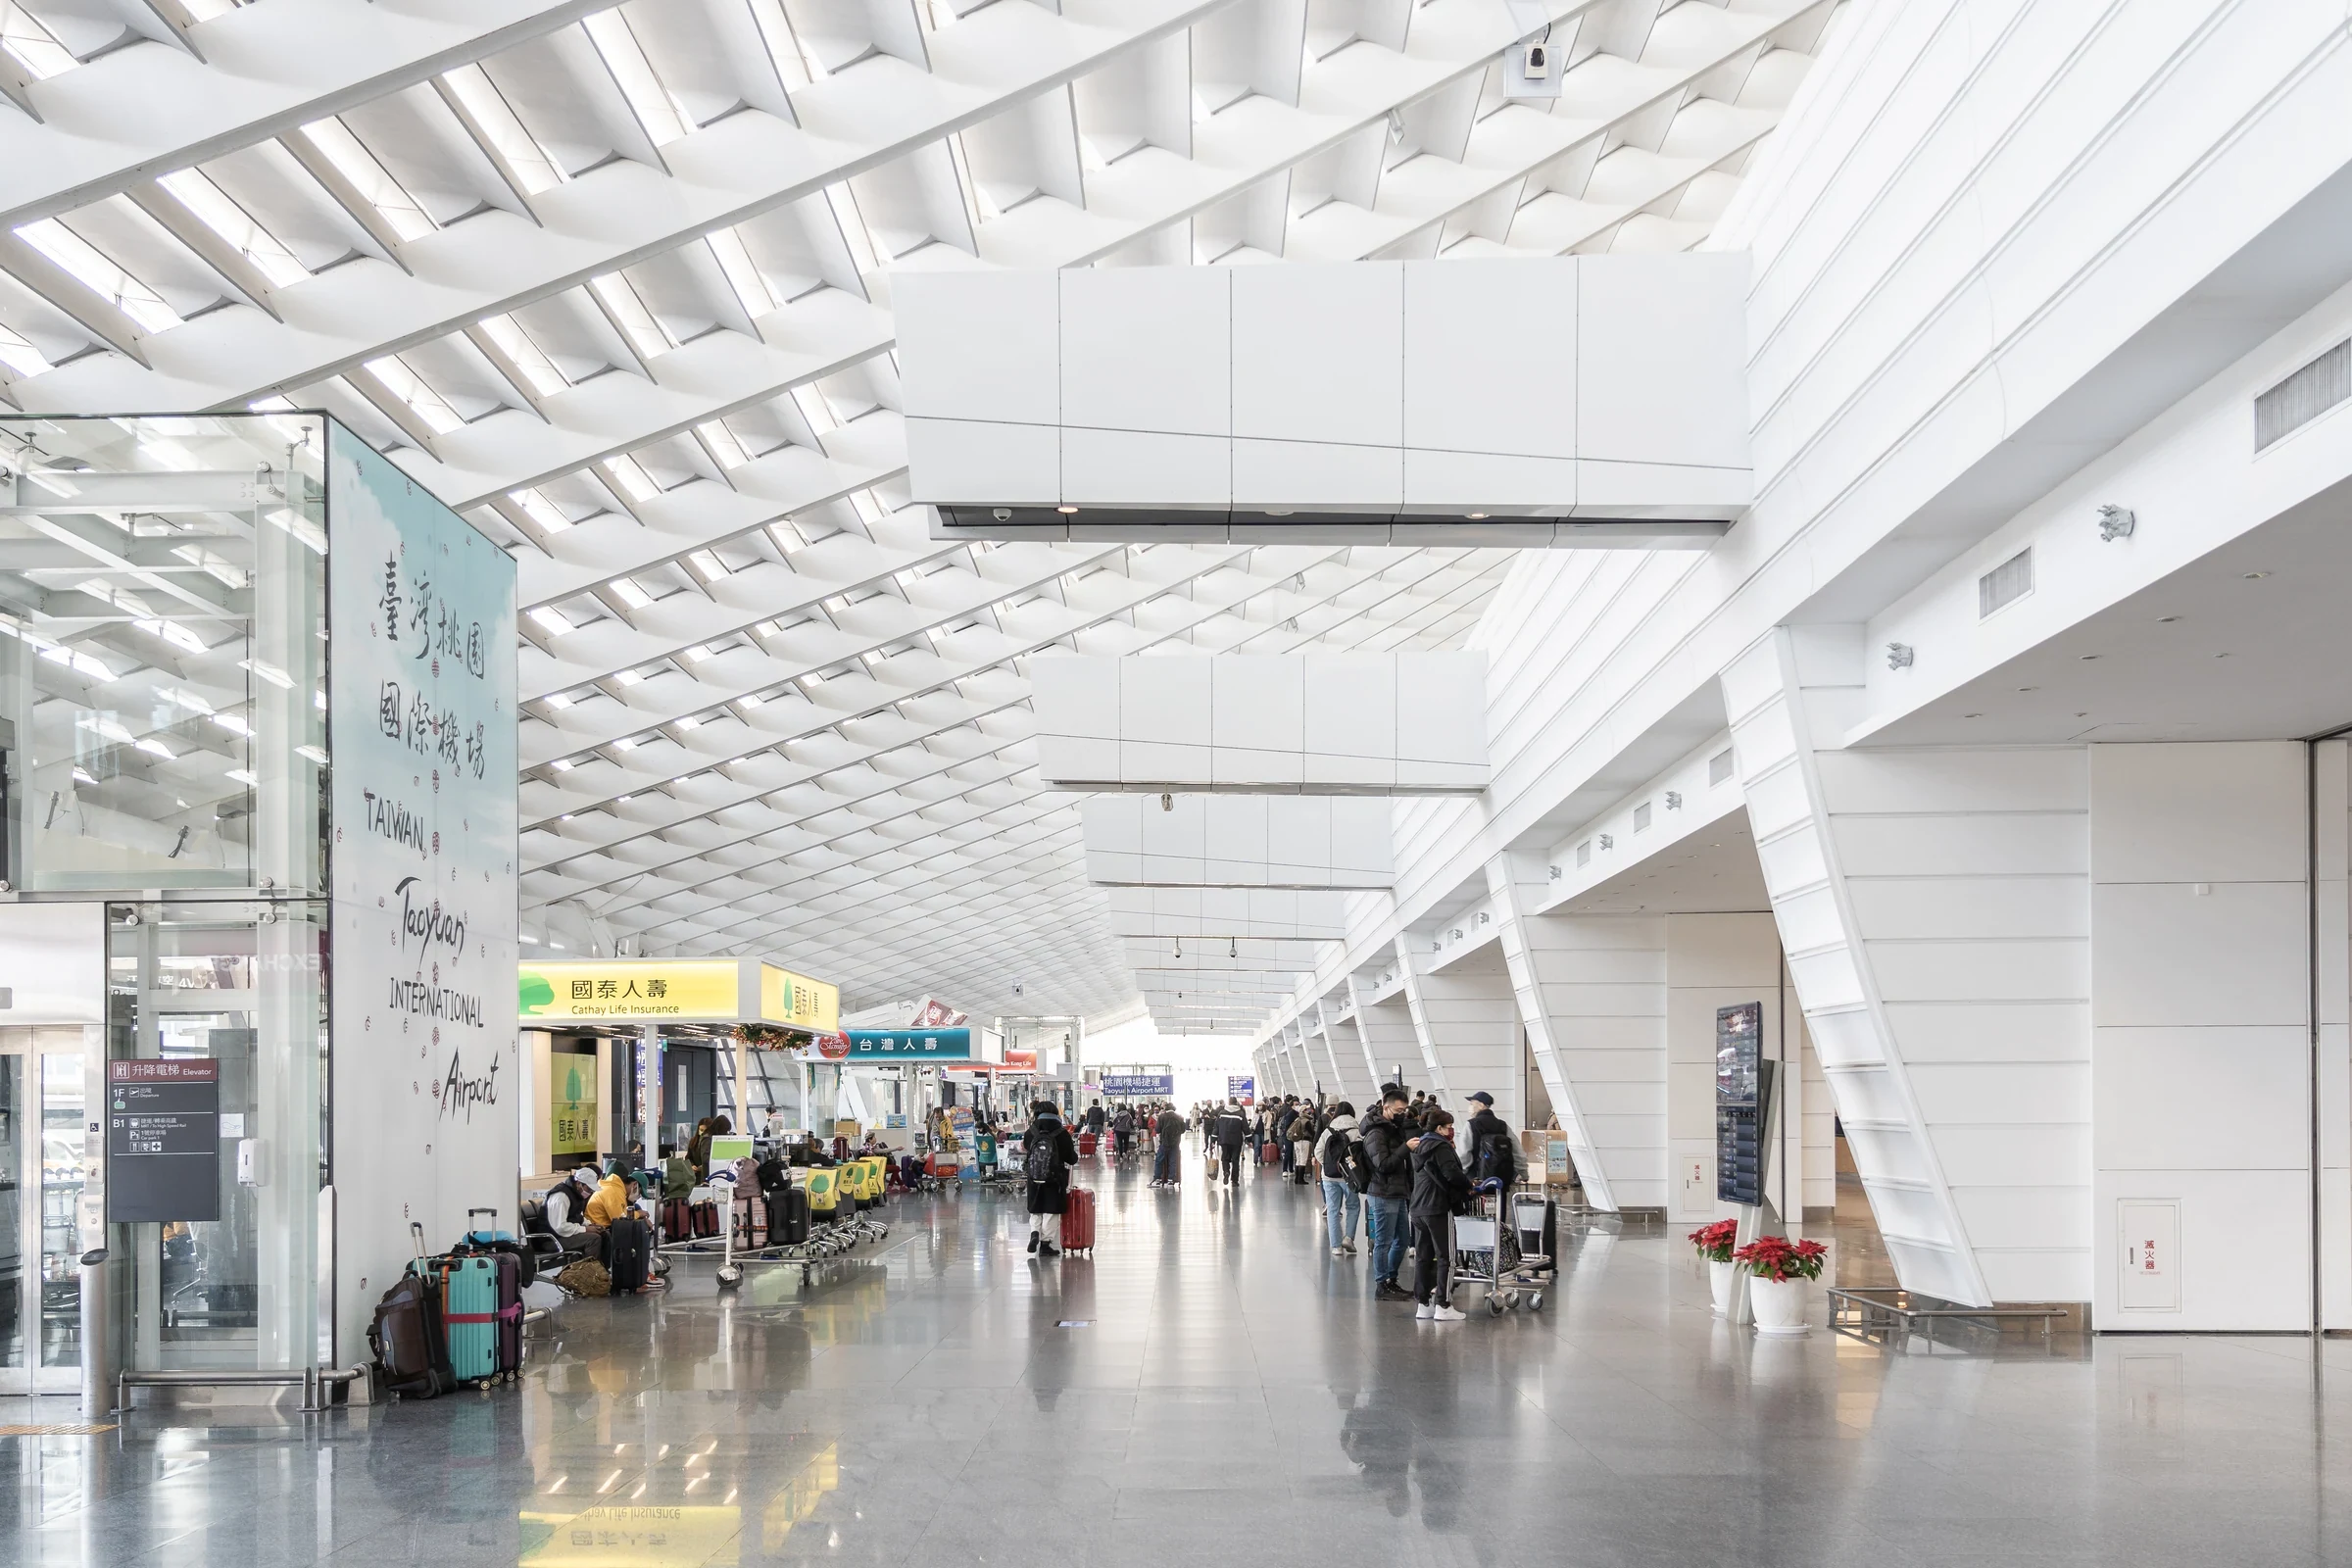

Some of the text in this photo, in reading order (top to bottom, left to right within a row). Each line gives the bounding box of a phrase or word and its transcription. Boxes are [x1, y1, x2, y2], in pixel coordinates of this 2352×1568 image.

[379, 550, 484, 679] 臺灣桃園
[379, 679, 484, 780] 國際機場
[365, 792, 422, 852] TAIWAN
[394, 876, 465, 970] Taoyuan
[571, 979, 667, 999] 國泰人壽
[389, 976, 484, 1028] INTERNATIONAL
[571, 1004, 679, 1016] Cathay Life Insurance
[795, 986, 818, 1018] 國泰人壽
[859, 1037, 938, 1052] 台灣人壽
[131, 1063, 179, 1077] 升降電梯
[1103, 1076, 1160, 1087] 桃園機場捷運
[113, 1088, 125, 1098] 1F
[439, 1045, 500, 1125] Airport
[113, 1119, 124, 1128] B1
[559, 1119, 588, 1141] 國泰人壽
[2144, 1240, 2154, 1269] 滅火器
